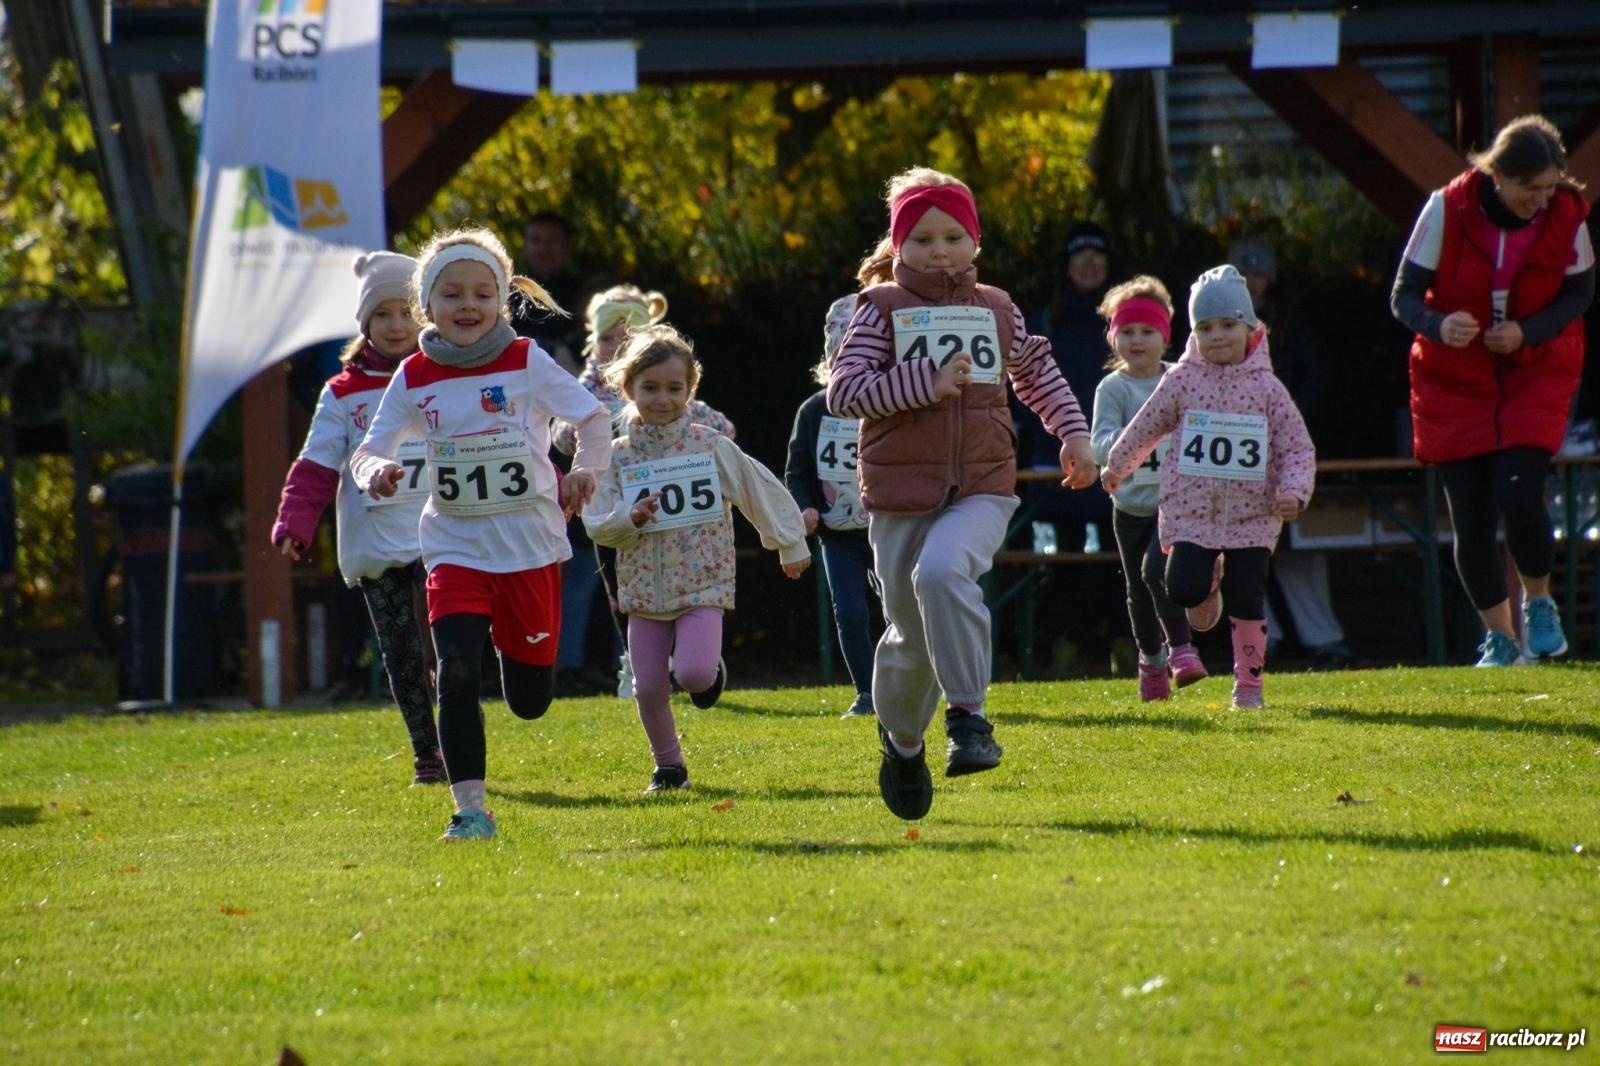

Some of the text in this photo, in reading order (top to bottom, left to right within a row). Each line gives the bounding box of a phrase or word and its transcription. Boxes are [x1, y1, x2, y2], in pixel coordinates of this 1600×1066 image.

[254, 23, 322, 59] PCS
[902, 334, 996, 369] 426
[459, 441, 526, 454] www.personalbest.pl
[820, 440, 858, 470] 43
[1183, 434, 1261, 468] 403
[438, 461, 529, 501] 513
[653, 460, 712, 474] www.personalbest.pl
